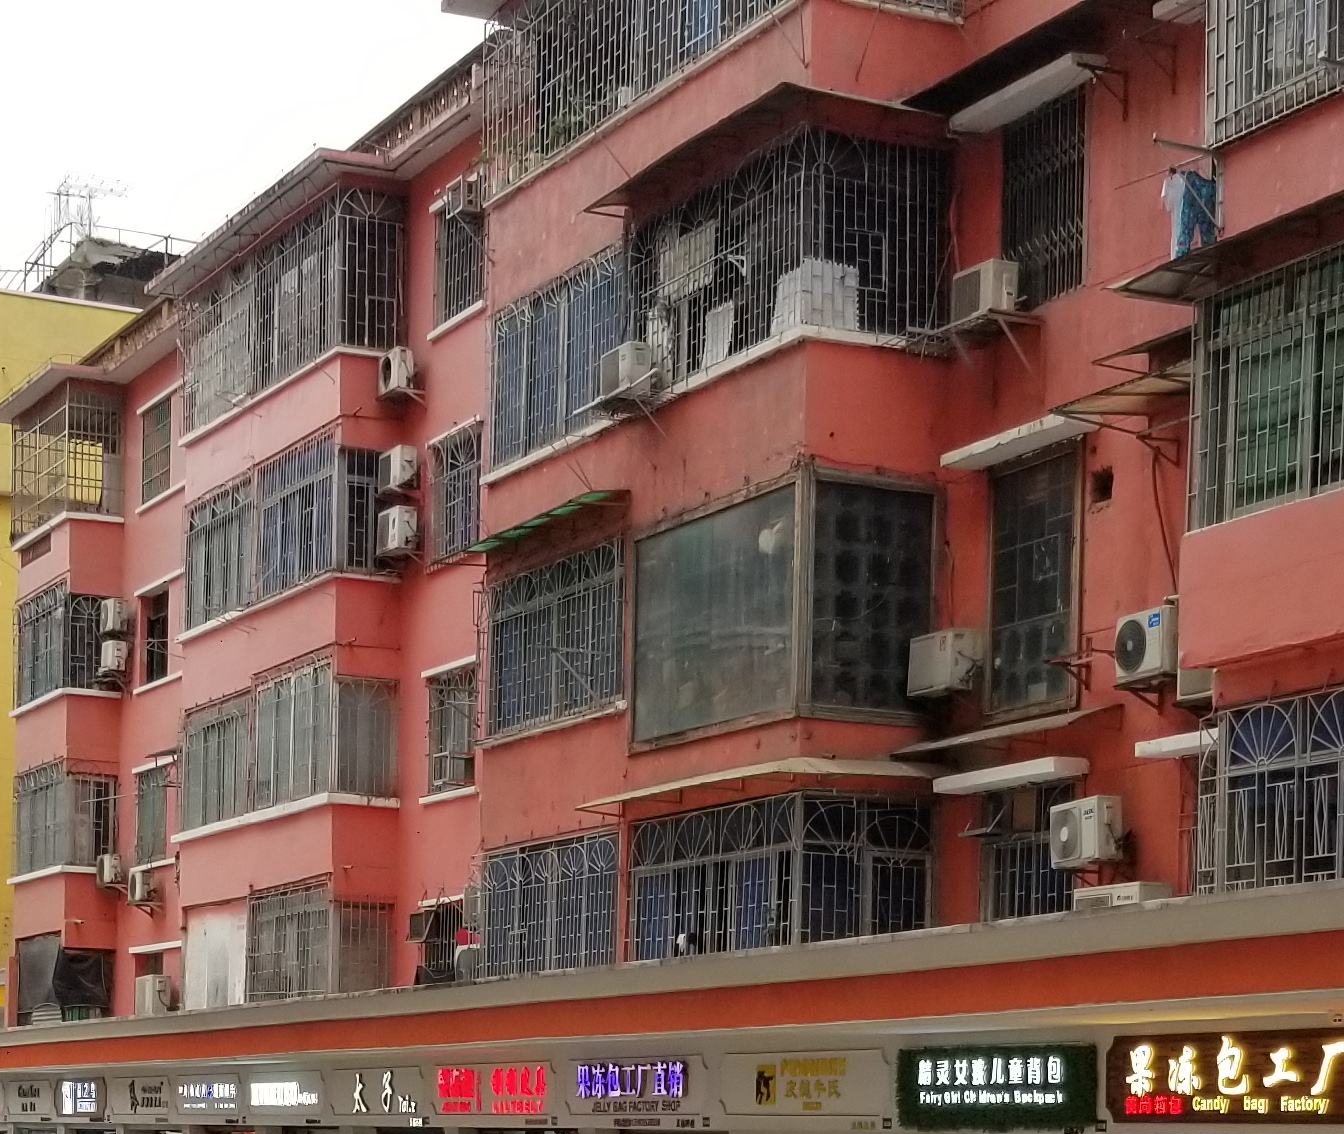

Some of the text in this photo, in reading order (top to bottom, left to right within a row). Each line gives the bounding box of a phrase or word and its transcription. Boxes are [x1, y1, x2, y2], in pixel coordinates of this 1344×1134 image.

[576, 1061, 685, 1099] 果冻包工厂直销
[917, 1056, 1062, 1085] 精灵女孩儿童背包
[592, 1100, 681, 1112] JELLY BAG FACTORY SHOP
[919, 1091, 943, 1106] Fairy
[944, 1090, 961, 1104] Girl
[1014, 1089, 1063, 1105] Backpack
[1192, 1094, 1331, 1115] Candy bag Factory
